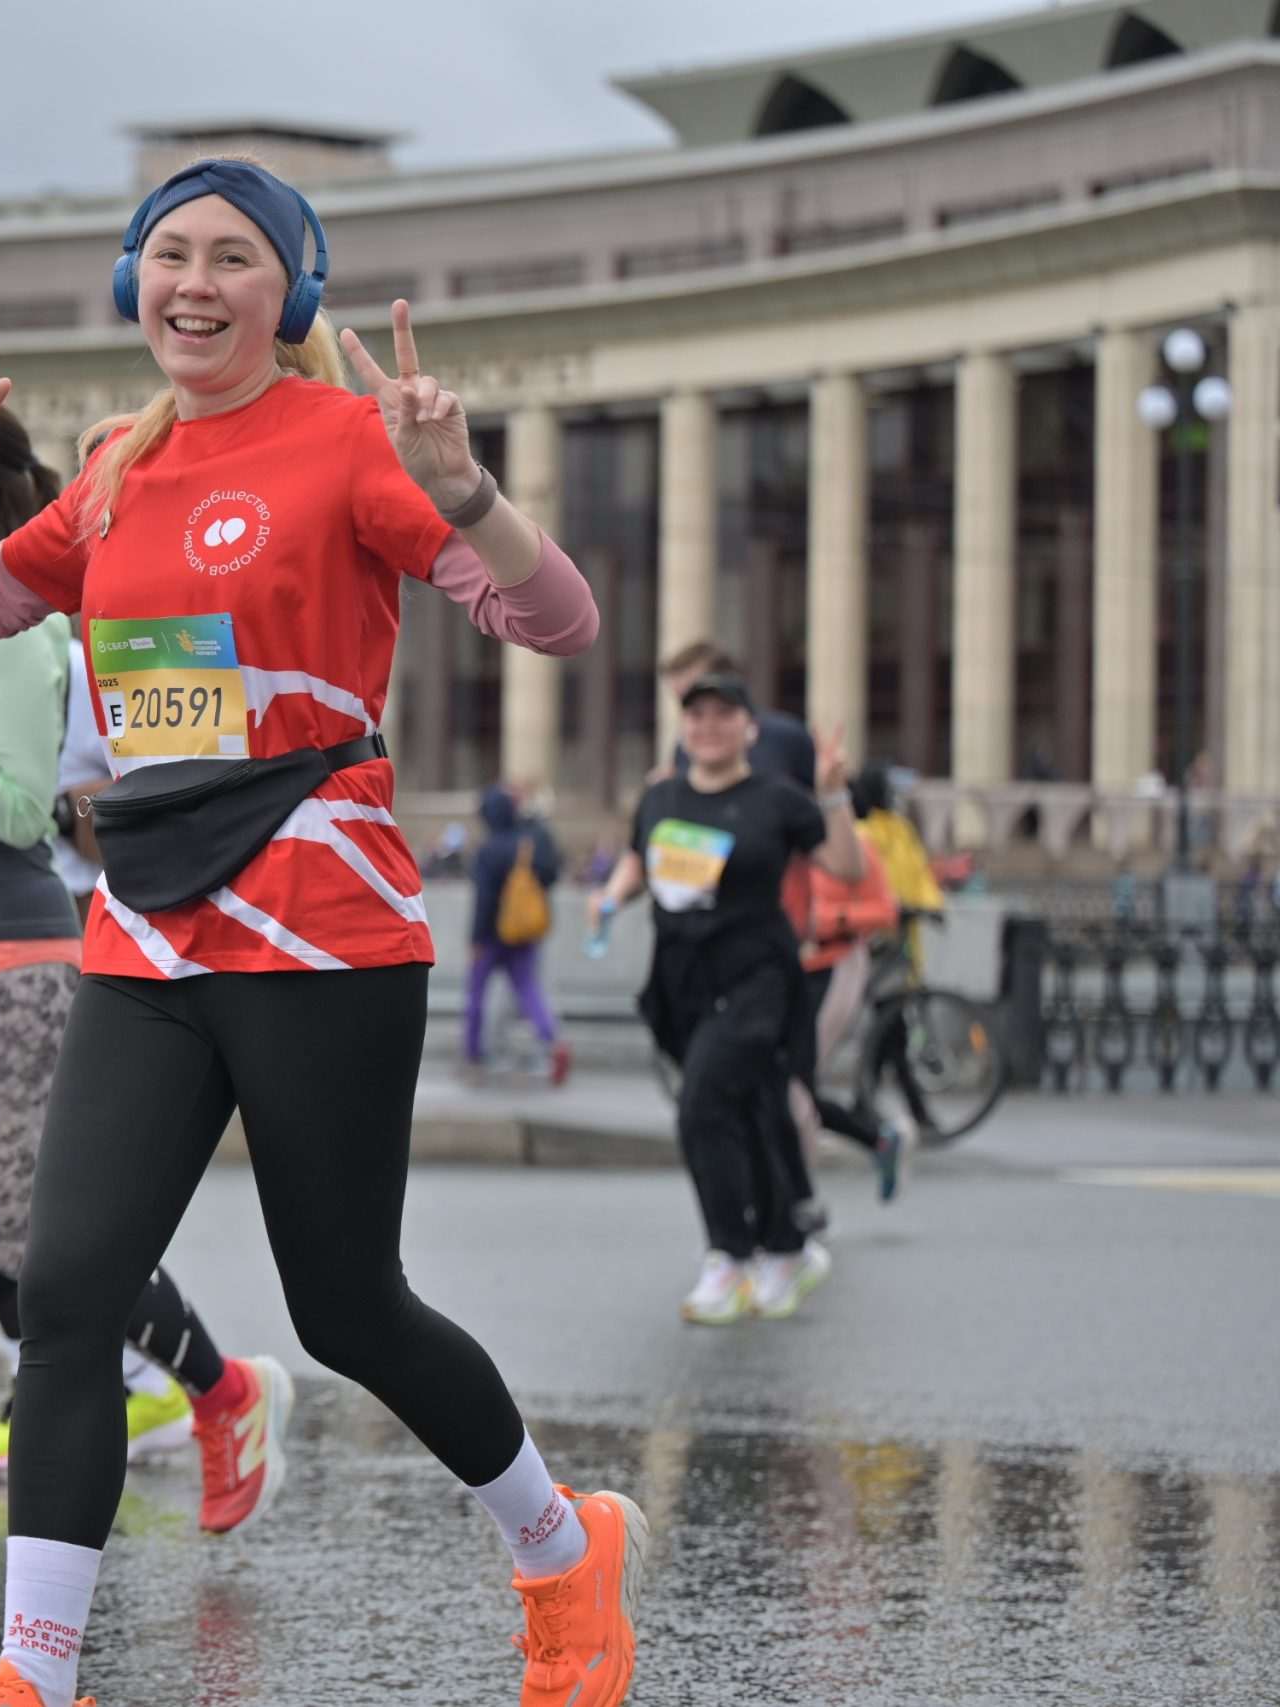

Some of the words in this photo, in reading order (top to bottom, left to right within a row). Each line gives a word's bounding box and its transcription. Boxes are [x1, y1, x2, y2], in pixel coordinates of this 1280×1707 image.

[187, 489, 271, 525] сообщество
[183, 530, 206, 573] крови
[208, 525, 271, 576] доноров
[97, 678, 119, 688] 2025
[130, 687, 222, 729] 20591
[8, 1625, 37, 1639] ЭТО
[40, 1630, 50, 1641] В
[13, 1613, 24, 1626] Я
